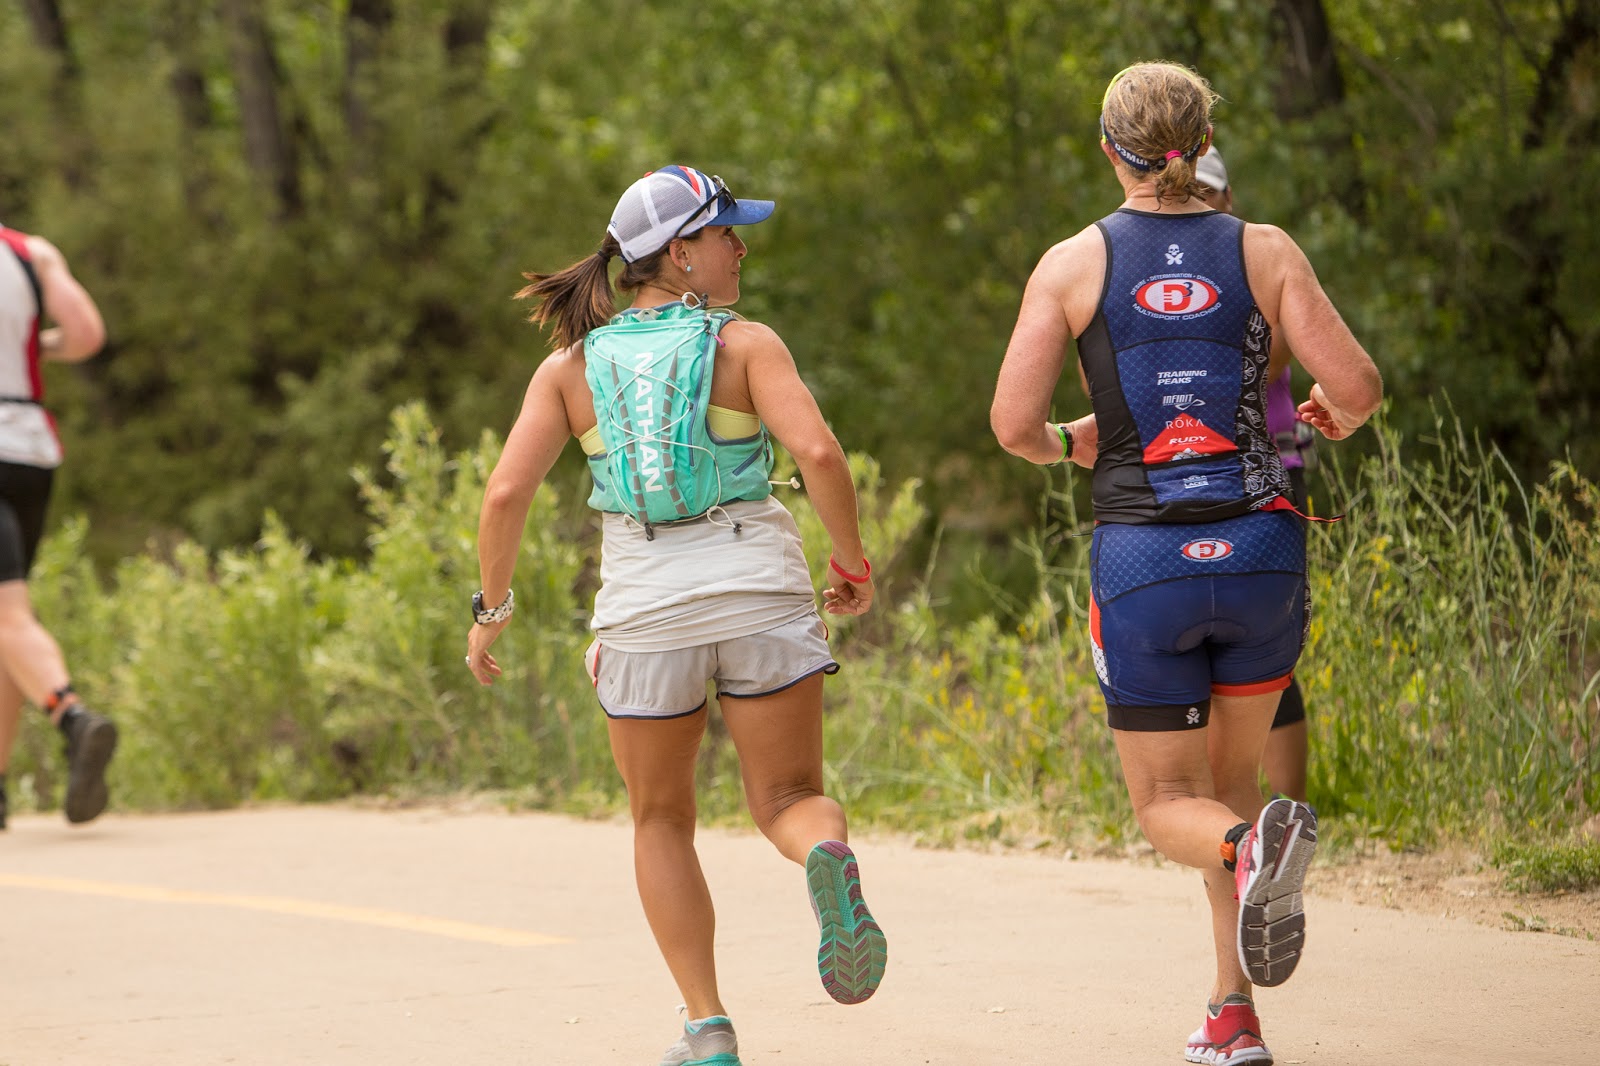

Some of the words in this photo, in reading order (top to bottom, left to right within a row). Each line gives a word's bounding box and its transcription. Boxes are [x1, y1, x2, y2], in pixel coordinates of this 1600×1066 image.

[1149, 273, 1193, 281] DETERMINATION
[1132, 302, 1181, 321] MULTISPORT
[1182, 302, 1222, 321] COACHING
[1157, 370, 1207, 379] TRAINING
[1157, 377, 1192, 386] PEAKS
[635, 352, 663, 492] NATHAN
[1169, 436, 1207, 445] RUDY
